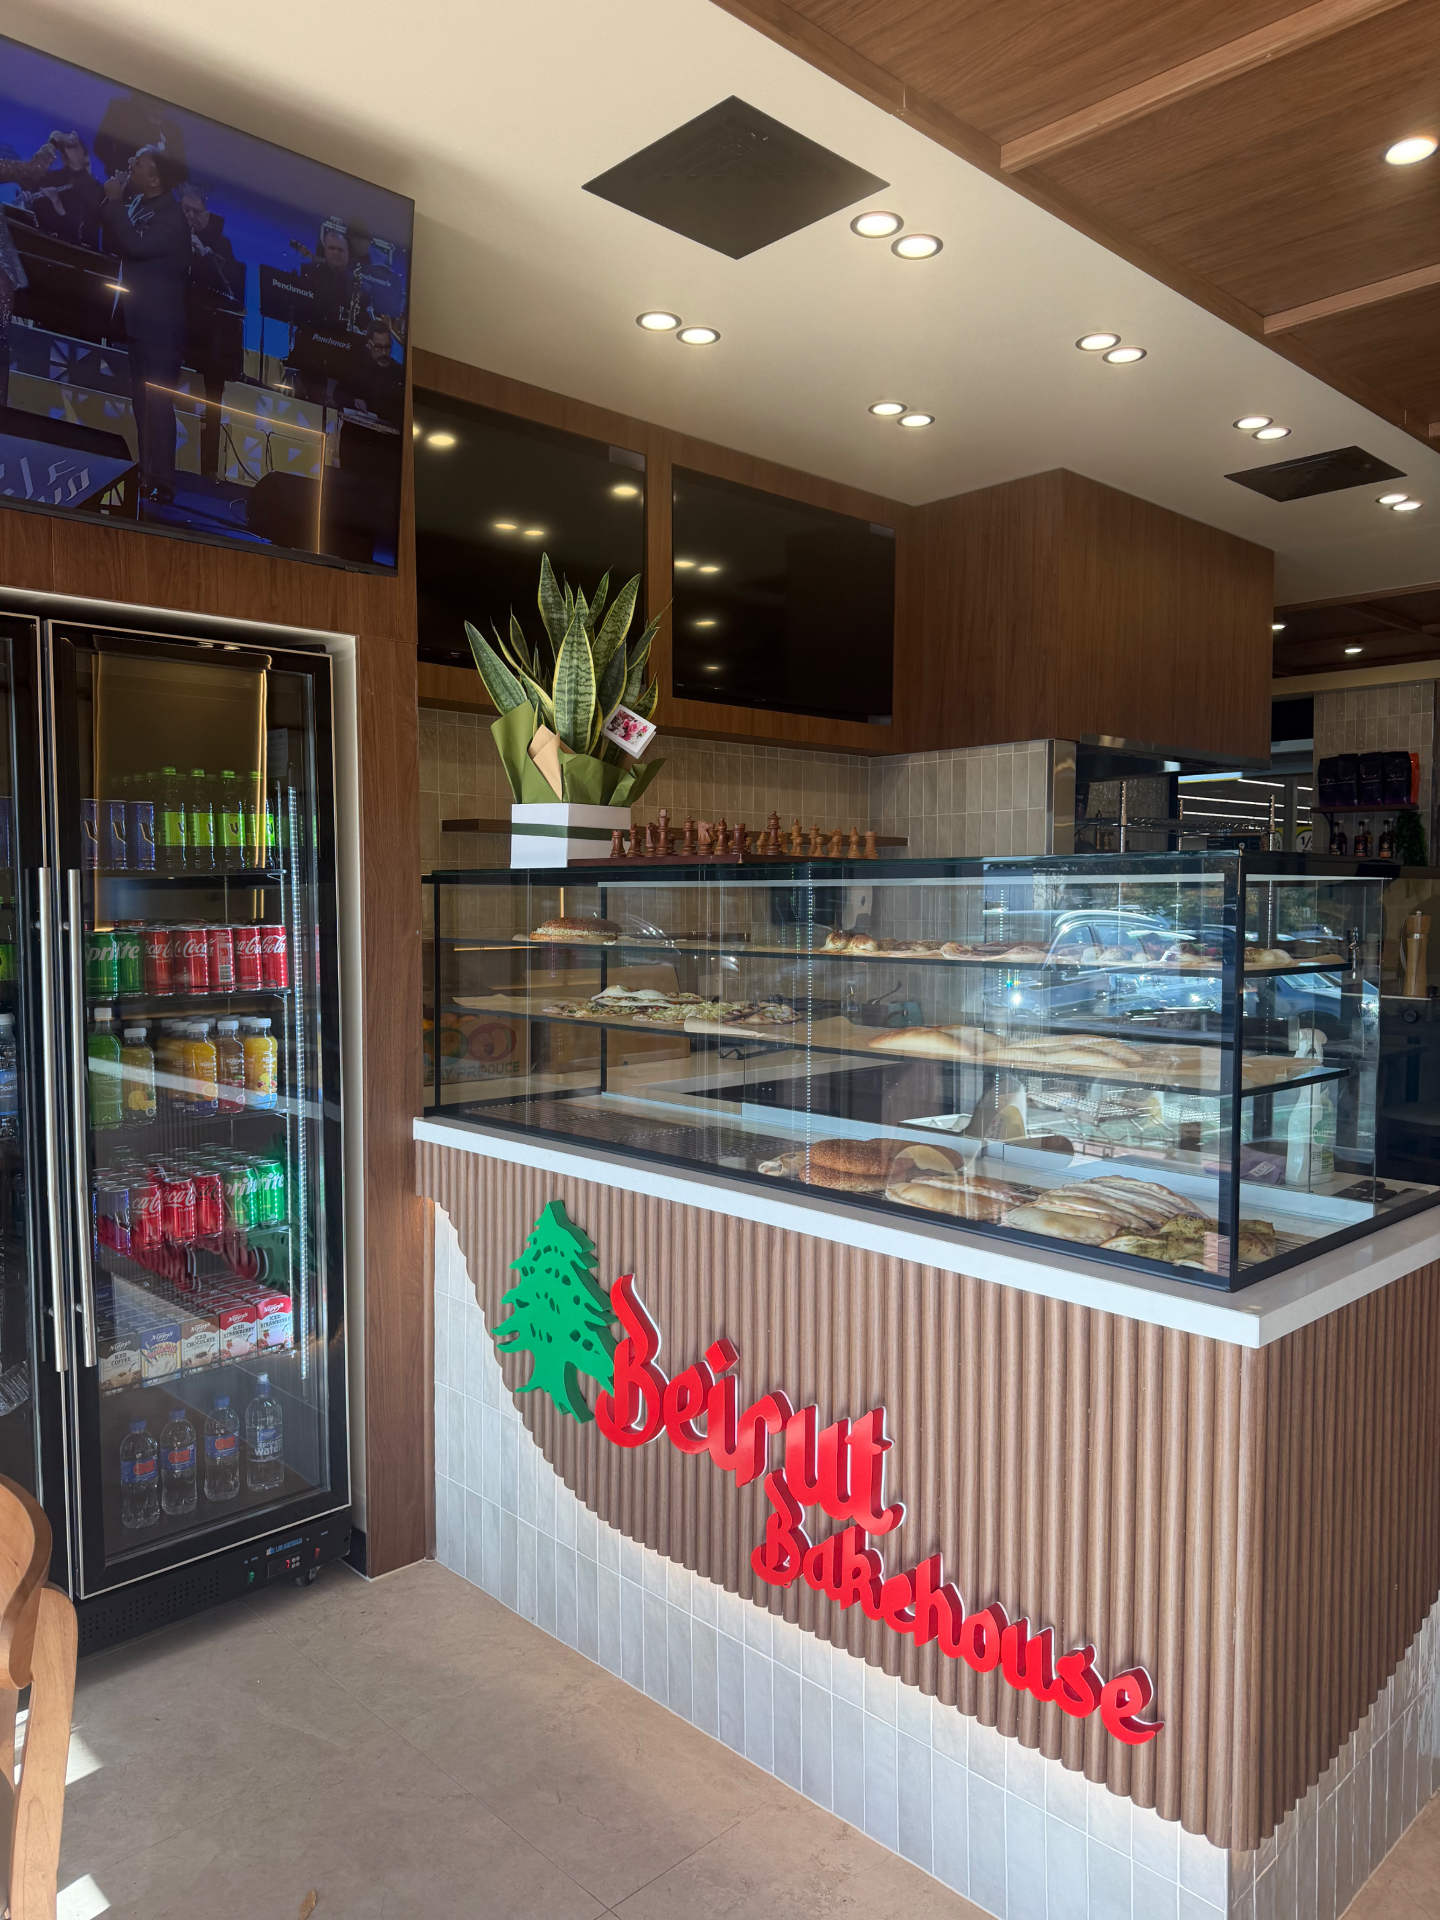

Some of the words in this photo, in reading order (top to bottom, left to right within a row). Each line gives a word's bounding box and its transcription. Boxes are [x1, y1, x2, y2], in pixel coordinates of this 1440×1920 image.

[359, 272, 392, 288] nchmark
[272, 278, 314, 299] Benchmark
[312, 333, 352, 350] Benchmark
[457, 1060, 520, 1079] PRODUCE
[262, 1301, 285, 1314] Nippy's
[227, 1311, 249, 1324] Nippy's
[189, 1321, 212, 1334] Nippy's
[222, 1326, 255, 1339] STRAWBERRY
[232, 1323, 245, 1331] ICED
[150, 1330, 175, 1343] Nippy's
[185, 1336, 216, 1349] CHOCOLATE
[194, 1333, 207, 1341] ICED
[108, 1339, 132, 1353] Nippy's
[110, 1357, 132, 1367] COFFEE
[597, 1273, 905, 1535] Beirut
[751, 1468, 1164, 1746] Bakehouse
